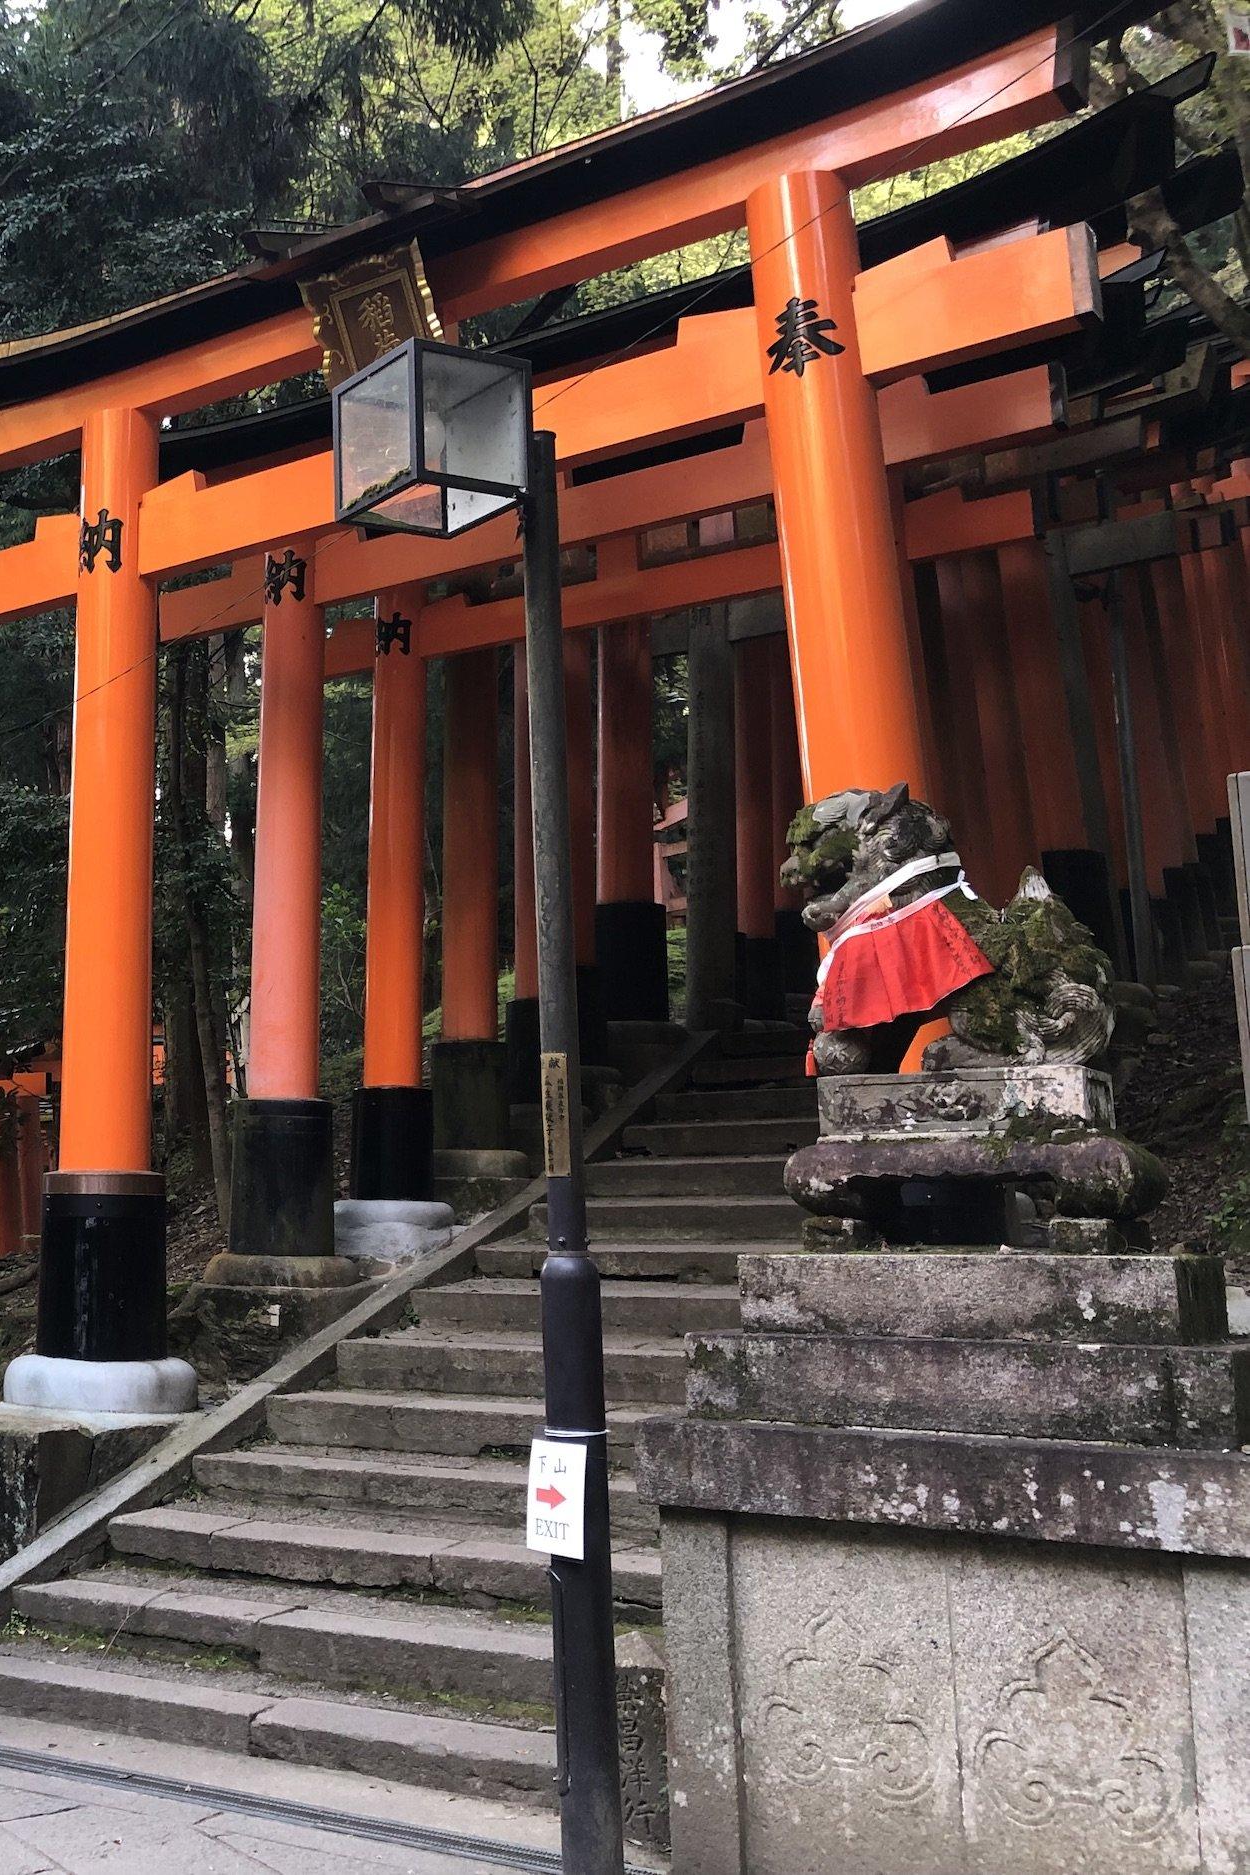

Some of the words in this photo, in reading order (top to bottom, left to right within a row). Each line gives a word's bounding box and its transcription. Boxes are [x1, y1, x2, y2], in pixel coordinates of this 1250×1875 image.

[766, 297, 846, 377] 奉
[79, 508, 124, 575] 納
[264, 550, 307, 606] 納
[375, 612, 412, 656] 納
[538, 1456, 567, 1473] 下山
[535, 1518, 570, 1540] EXIT
